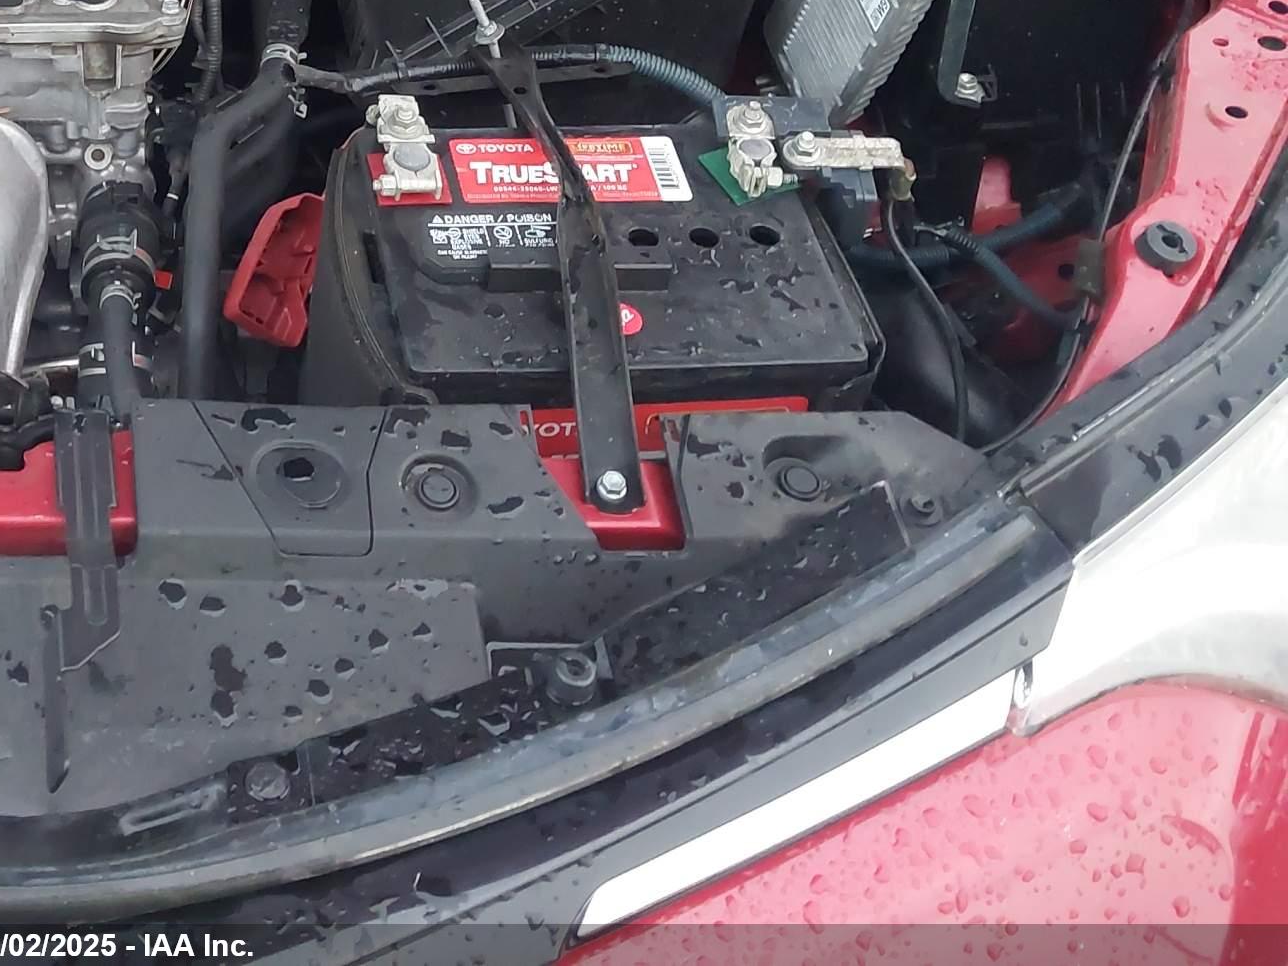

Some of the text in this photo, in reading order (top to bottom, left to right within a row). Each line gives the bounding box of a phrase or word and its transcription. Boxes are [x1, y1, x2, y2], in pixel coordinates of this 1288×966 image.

[478, 143, 534, 153] TOYOTA
[444, 214, 495, 224] DANGER
[506, 213, 552, 223] POISON
